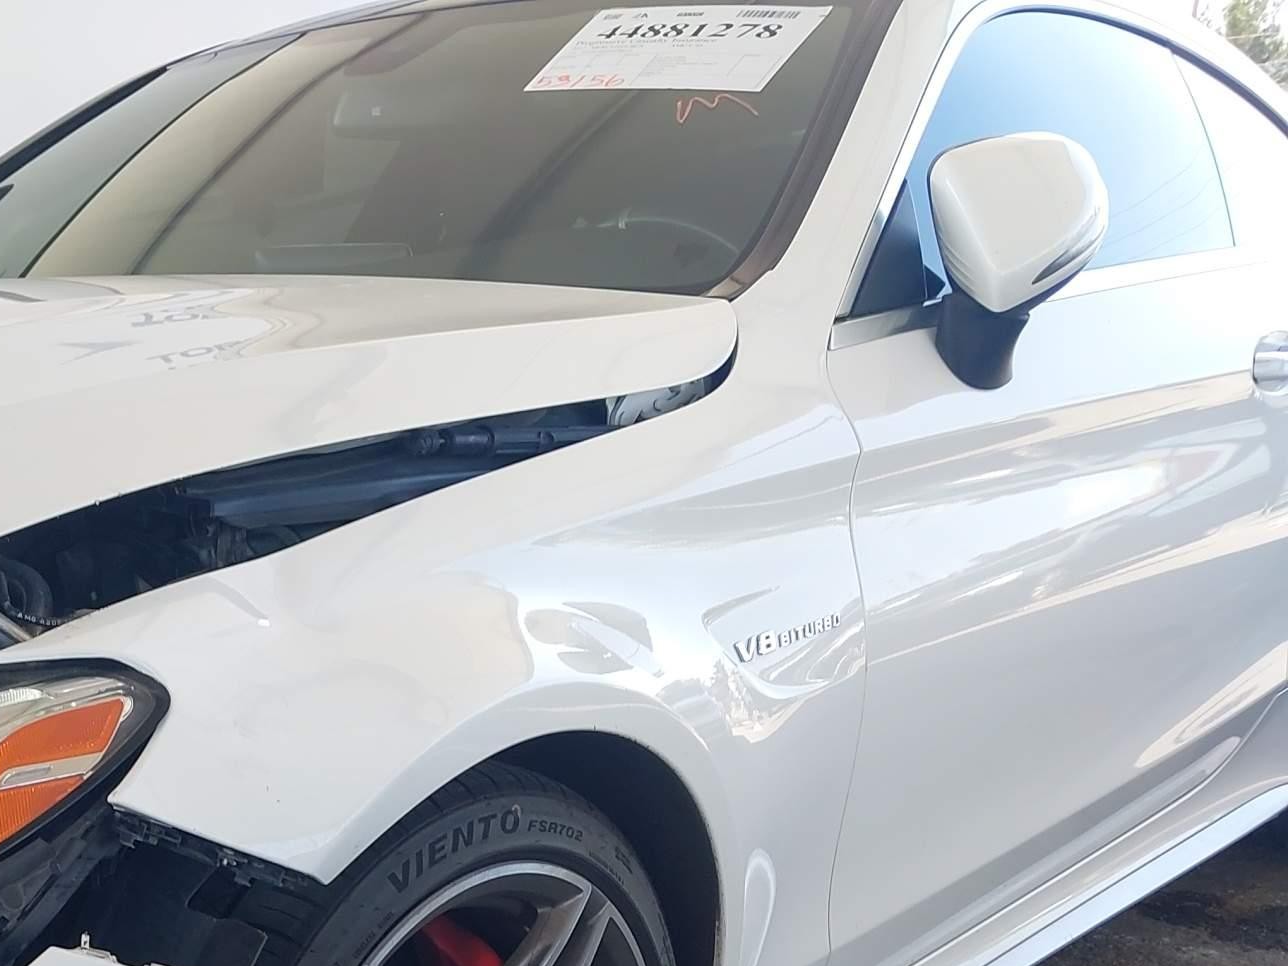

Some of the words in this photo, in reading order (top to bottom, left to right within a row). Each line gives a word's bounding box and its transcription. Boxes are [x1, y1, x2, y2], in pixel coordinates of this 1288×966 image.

[597, 23, 784, 39] 44881278
[732, 629, 778, 664] V8
[777, 612, 842, 648] BITURBO
[386, 807, 521, 894] VIENTO
[526, 818, 585, 843] FSR702
